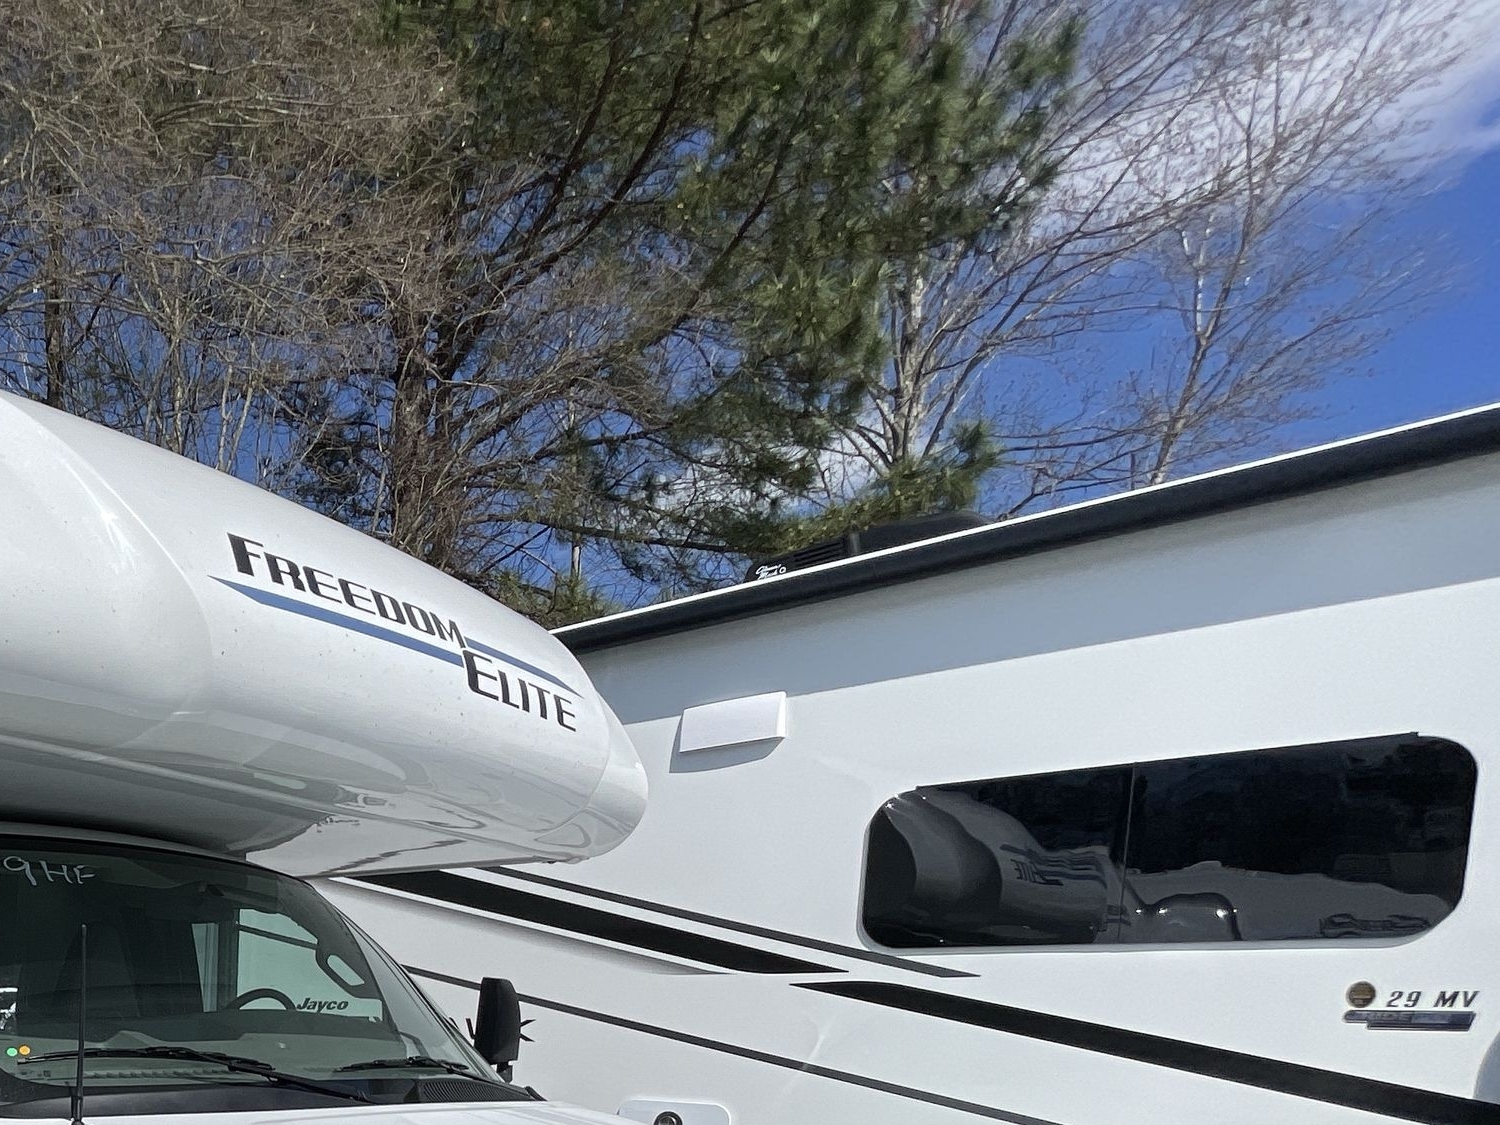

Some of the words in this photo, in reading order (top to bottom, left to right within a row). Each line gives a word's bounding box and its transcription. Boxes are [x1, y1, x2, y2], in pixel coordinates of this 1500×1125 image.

[227, 532, 467, 649] FREEDOM
[462, 649, 577, 732] ELITE
[297, 997, 349, 1013] Jayco
[1386, 990, 1422, 1008] 29
[1433, 990, 1481, 1008] MV
